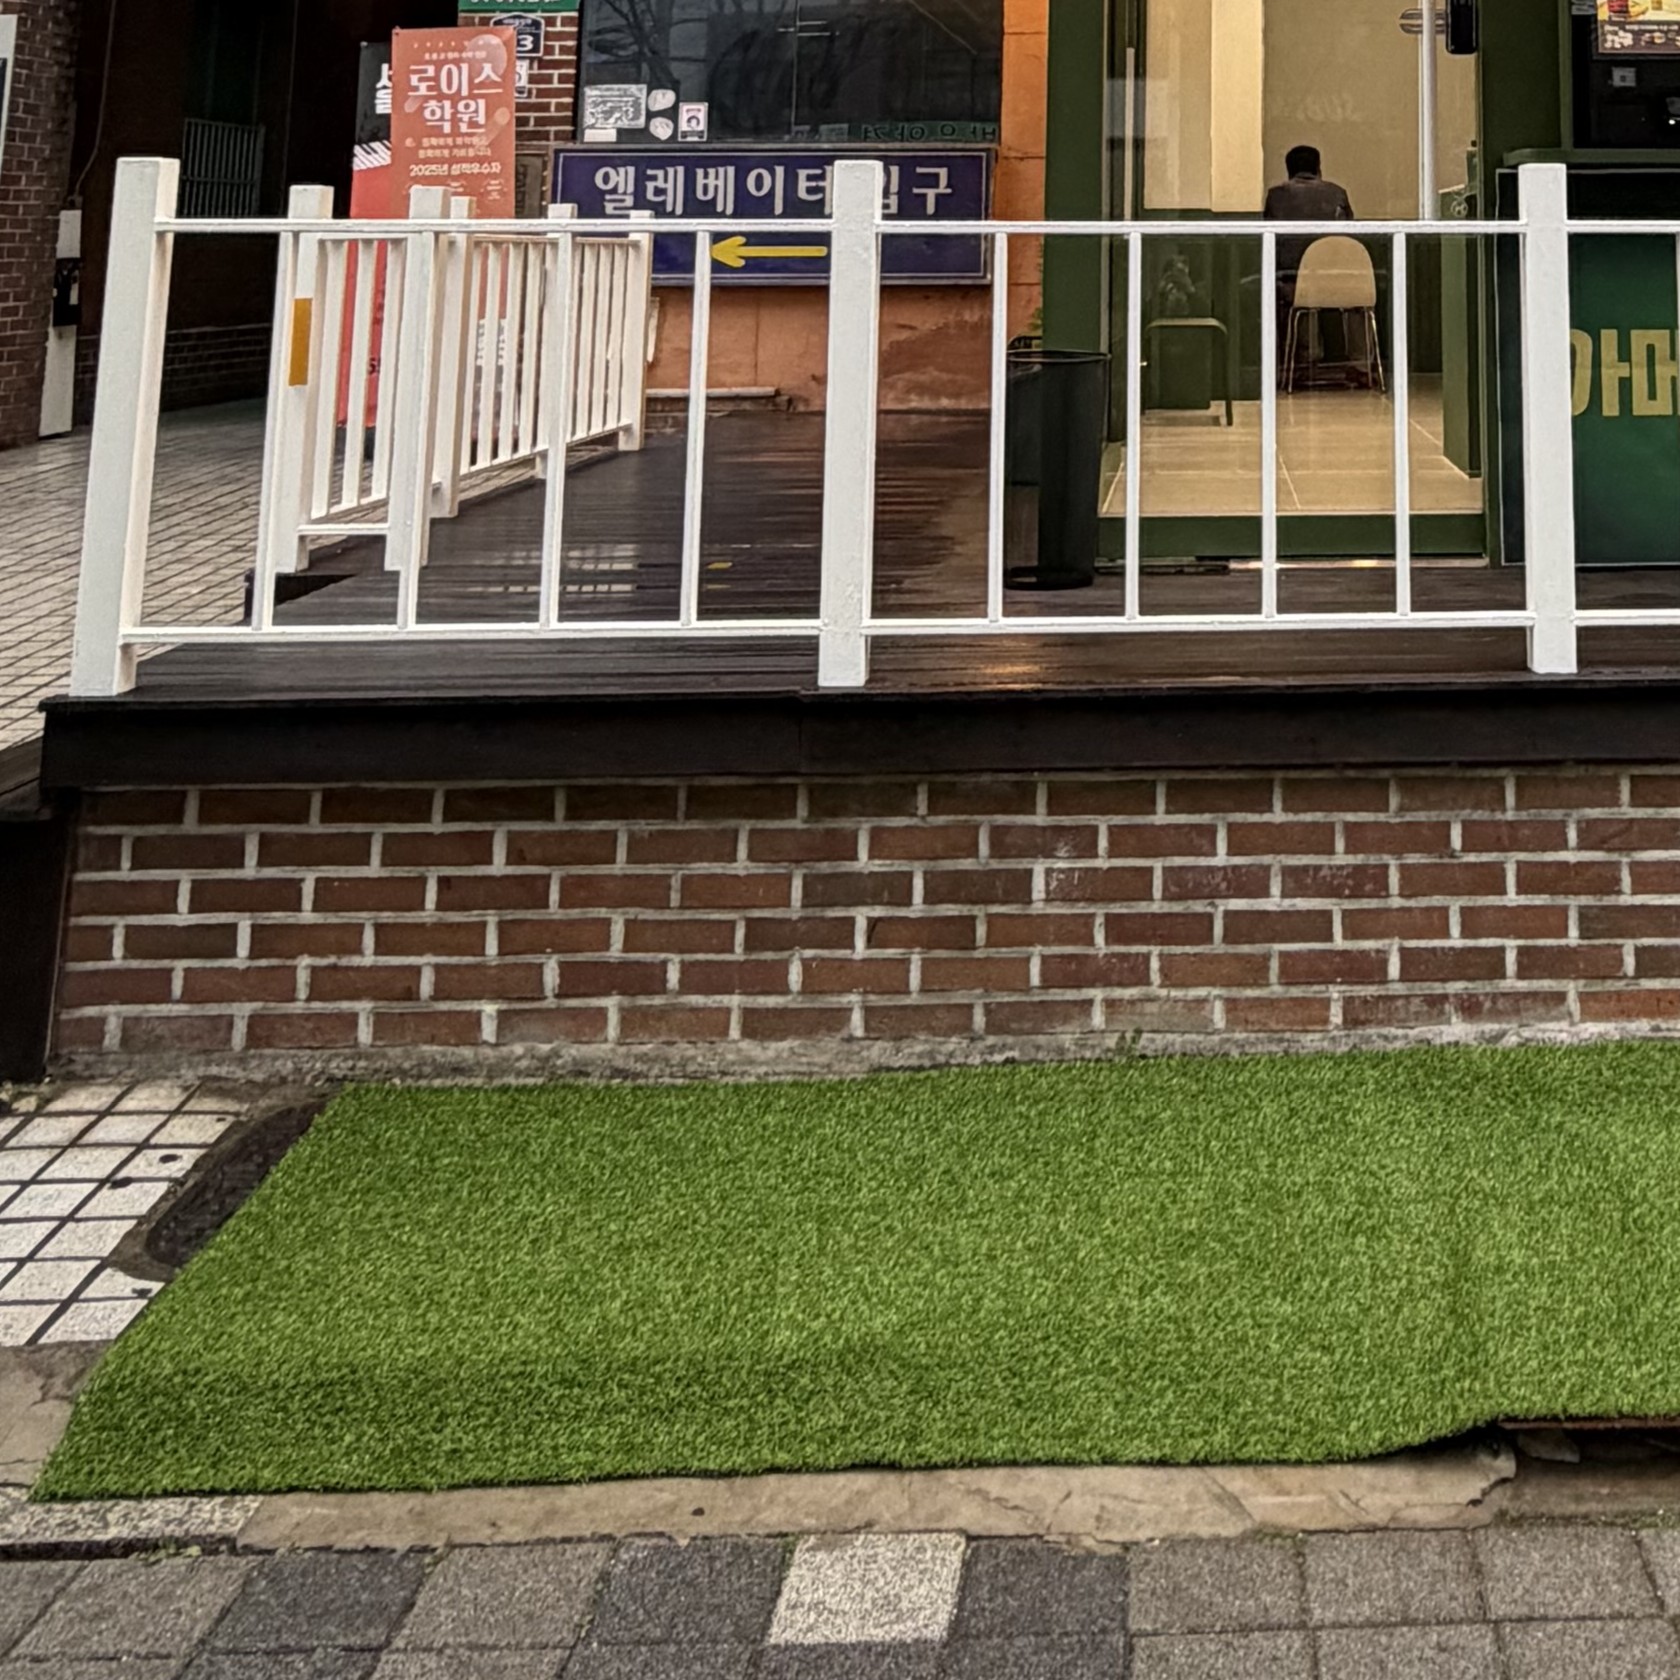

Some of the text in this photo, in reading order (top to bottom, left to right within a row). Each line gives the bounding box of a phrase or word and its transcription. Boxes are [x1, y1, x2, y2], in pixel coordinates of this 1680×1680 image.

[408, 63, 503, 96] 로이스
[423, 99, 486, 133] 학원
[594, 165, 833, 216] 엘레베이터
